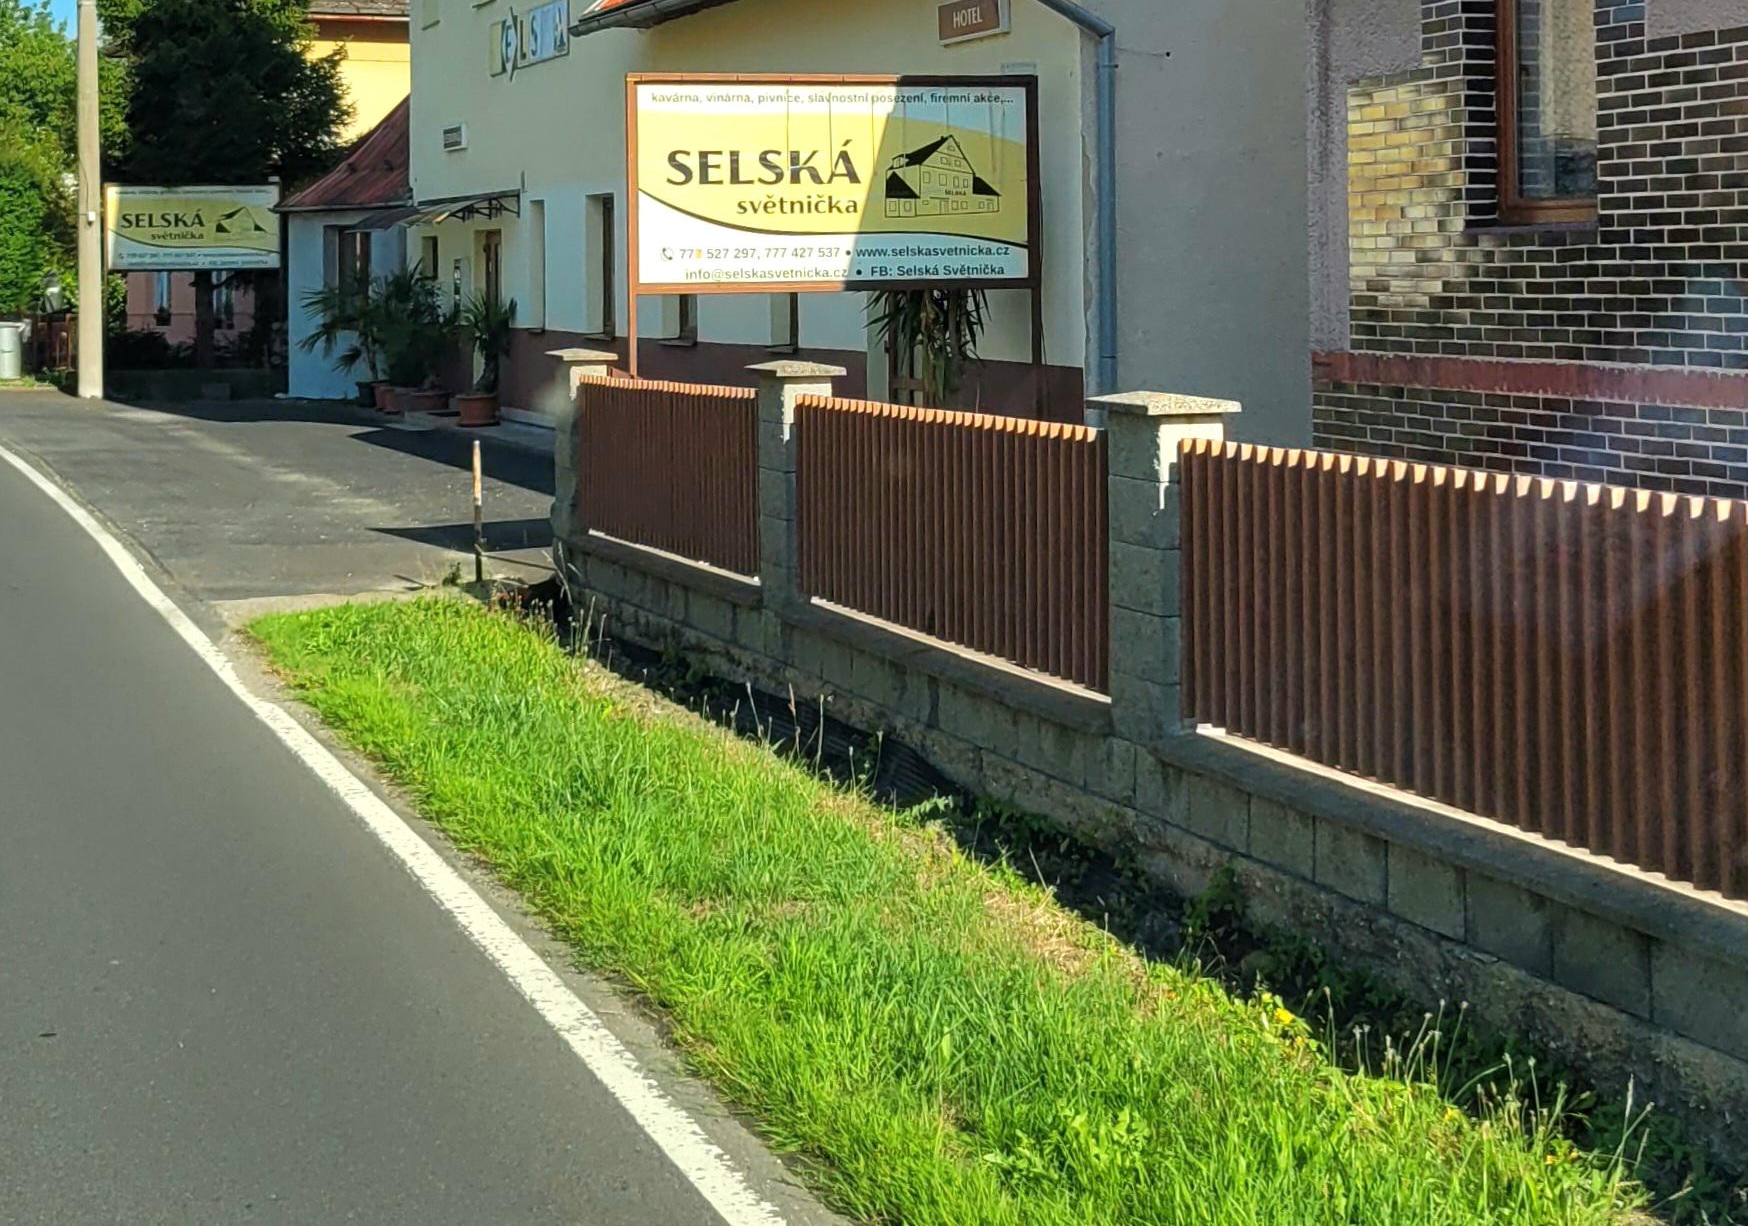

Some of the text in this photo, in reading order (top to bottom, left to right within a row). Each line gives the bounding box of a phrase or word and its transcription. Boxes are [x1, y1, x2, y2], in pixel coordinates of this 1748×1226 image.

[952, 6, 983, 29] HOTEL
[651, 92, 703, 104] kavárna,
[706, 92, 754, 104] vinárna,
[758, 92, 805, 105] pivnice,
[807, 92, 869, 104] slavnostní
[871, 91, 927, 105] posezení,
[930, 91, 971, 104] firemní
[666, 139, 861, 185] SELSKÁ
[736, 193, 858, 215] světnička
[121, 208, 206, 229] SELSKÁ
[706, 248, 729, 260] 527
[733, 247, 761, 260] 297,
[764, 247, 787, 259] 777
[791, 247, 814, 259] 427
[817, 247, 840, 259] 537
[855, 244, 1011, 258] www.selskasvetnicka.cz
[685, 262, 1005, 282] info@selskasvetnicka.cz FB: Selská Světnička
